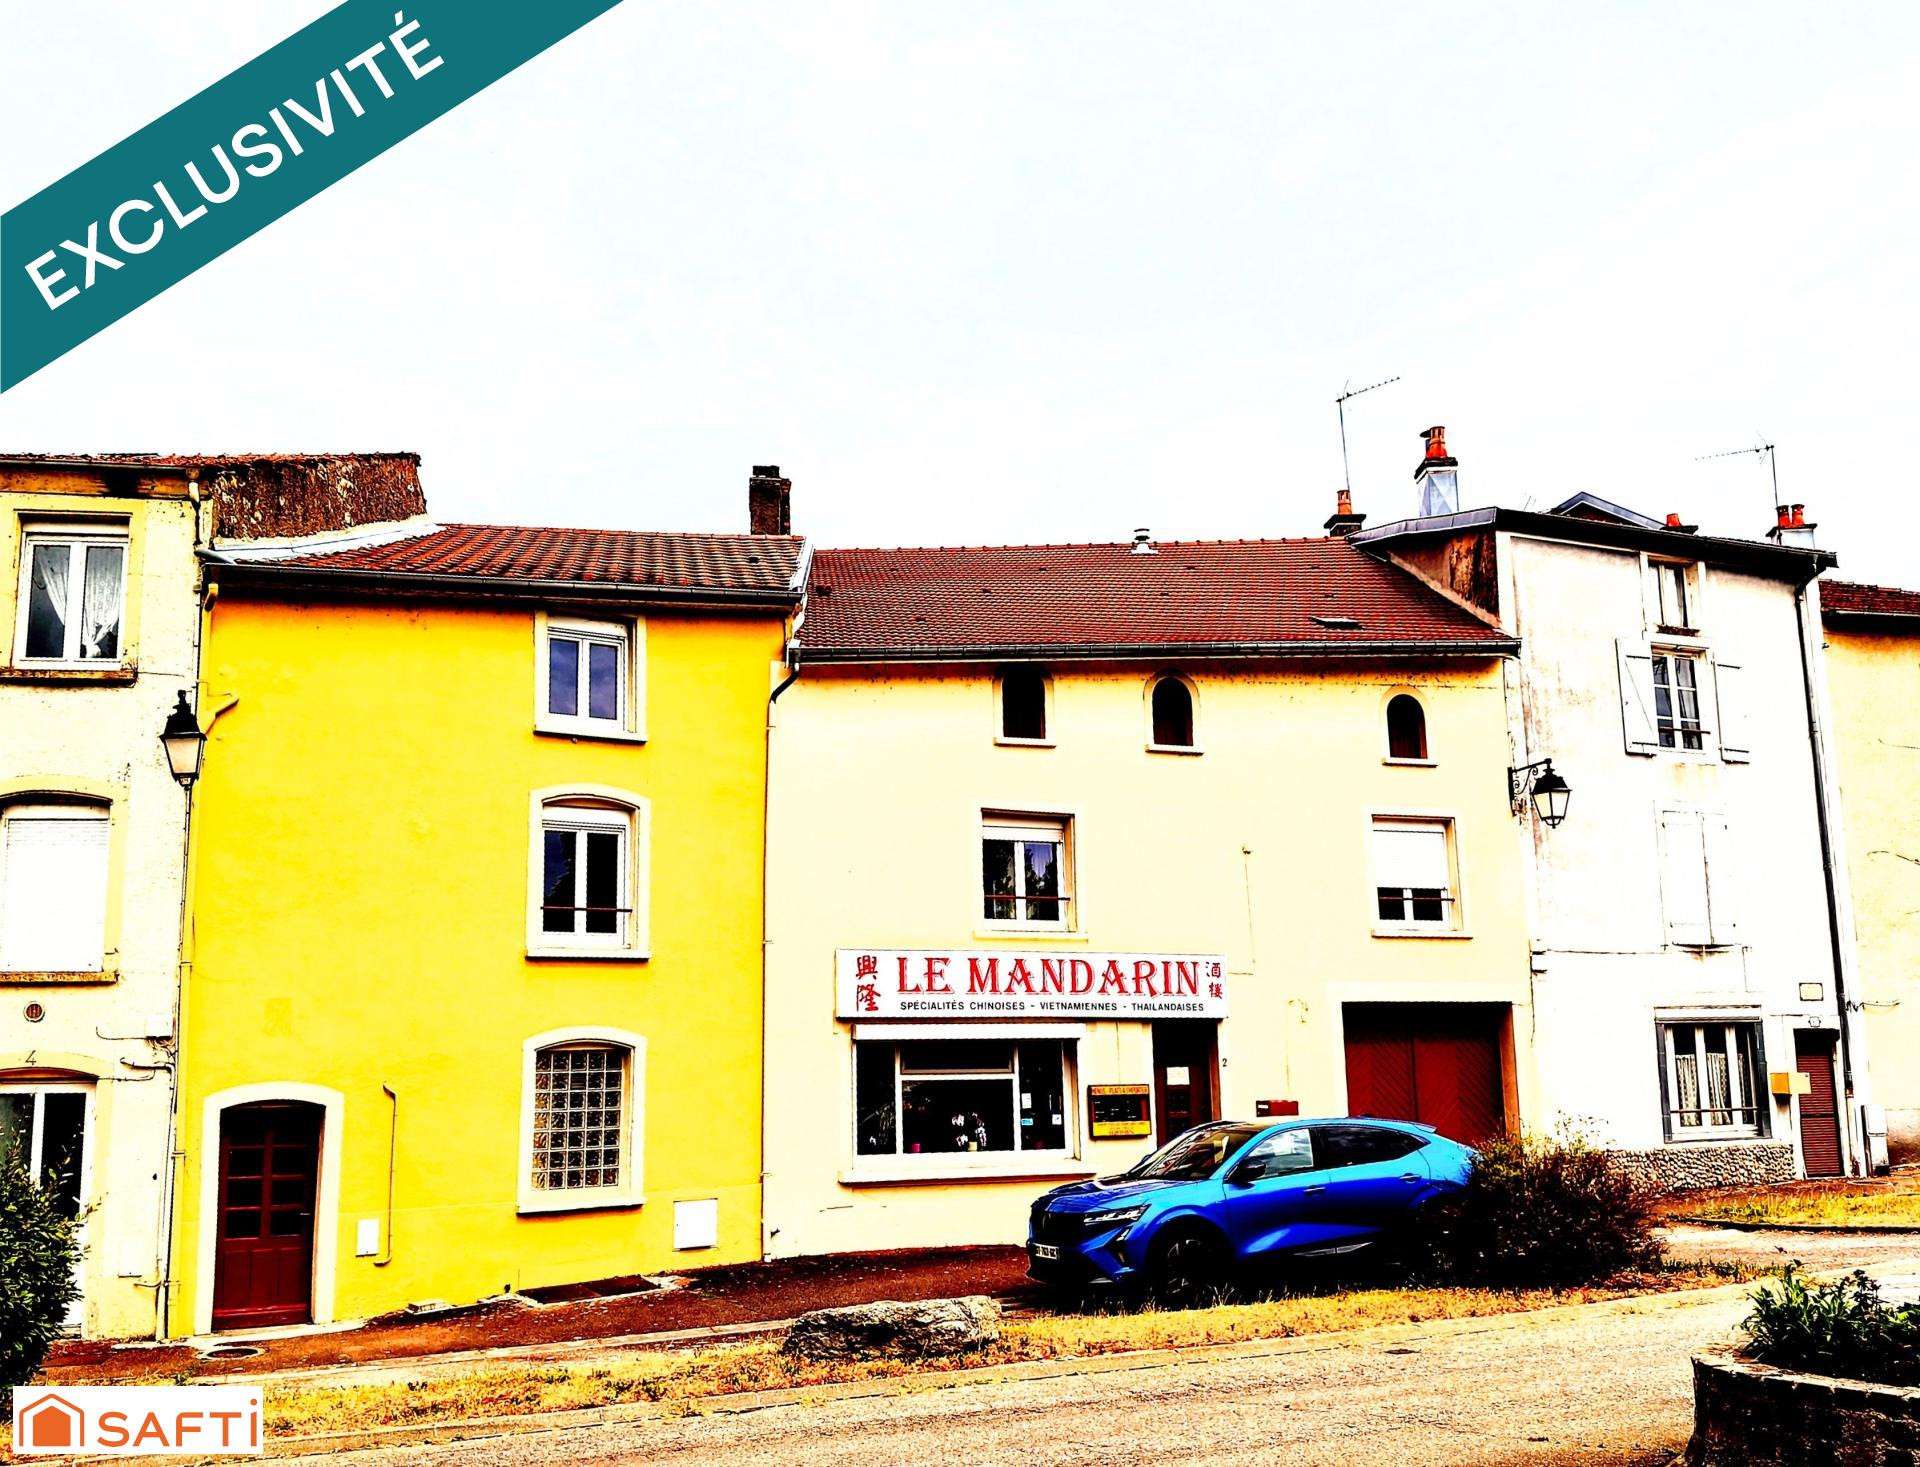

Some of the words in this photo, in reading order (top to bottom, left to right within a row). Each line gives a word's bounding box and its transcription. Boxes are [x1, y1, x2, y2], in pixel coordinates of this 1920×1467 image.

[896, 957, 954, 994] LE
[966, 958, 1200, 997] MANDARIN
[900, 1000, 965, 1011] SPÉCIALITÉS
[969, 1001, 1025, 1011] CHINOISES
[1039, 1001, 1118, 1012] VIETNAMIENNES
[1132, 1002, 1204, 1013] THAILANDAISES
[25, 1050, 37, 1065] 4
[1222, 1058, 1228, 1067] 2
